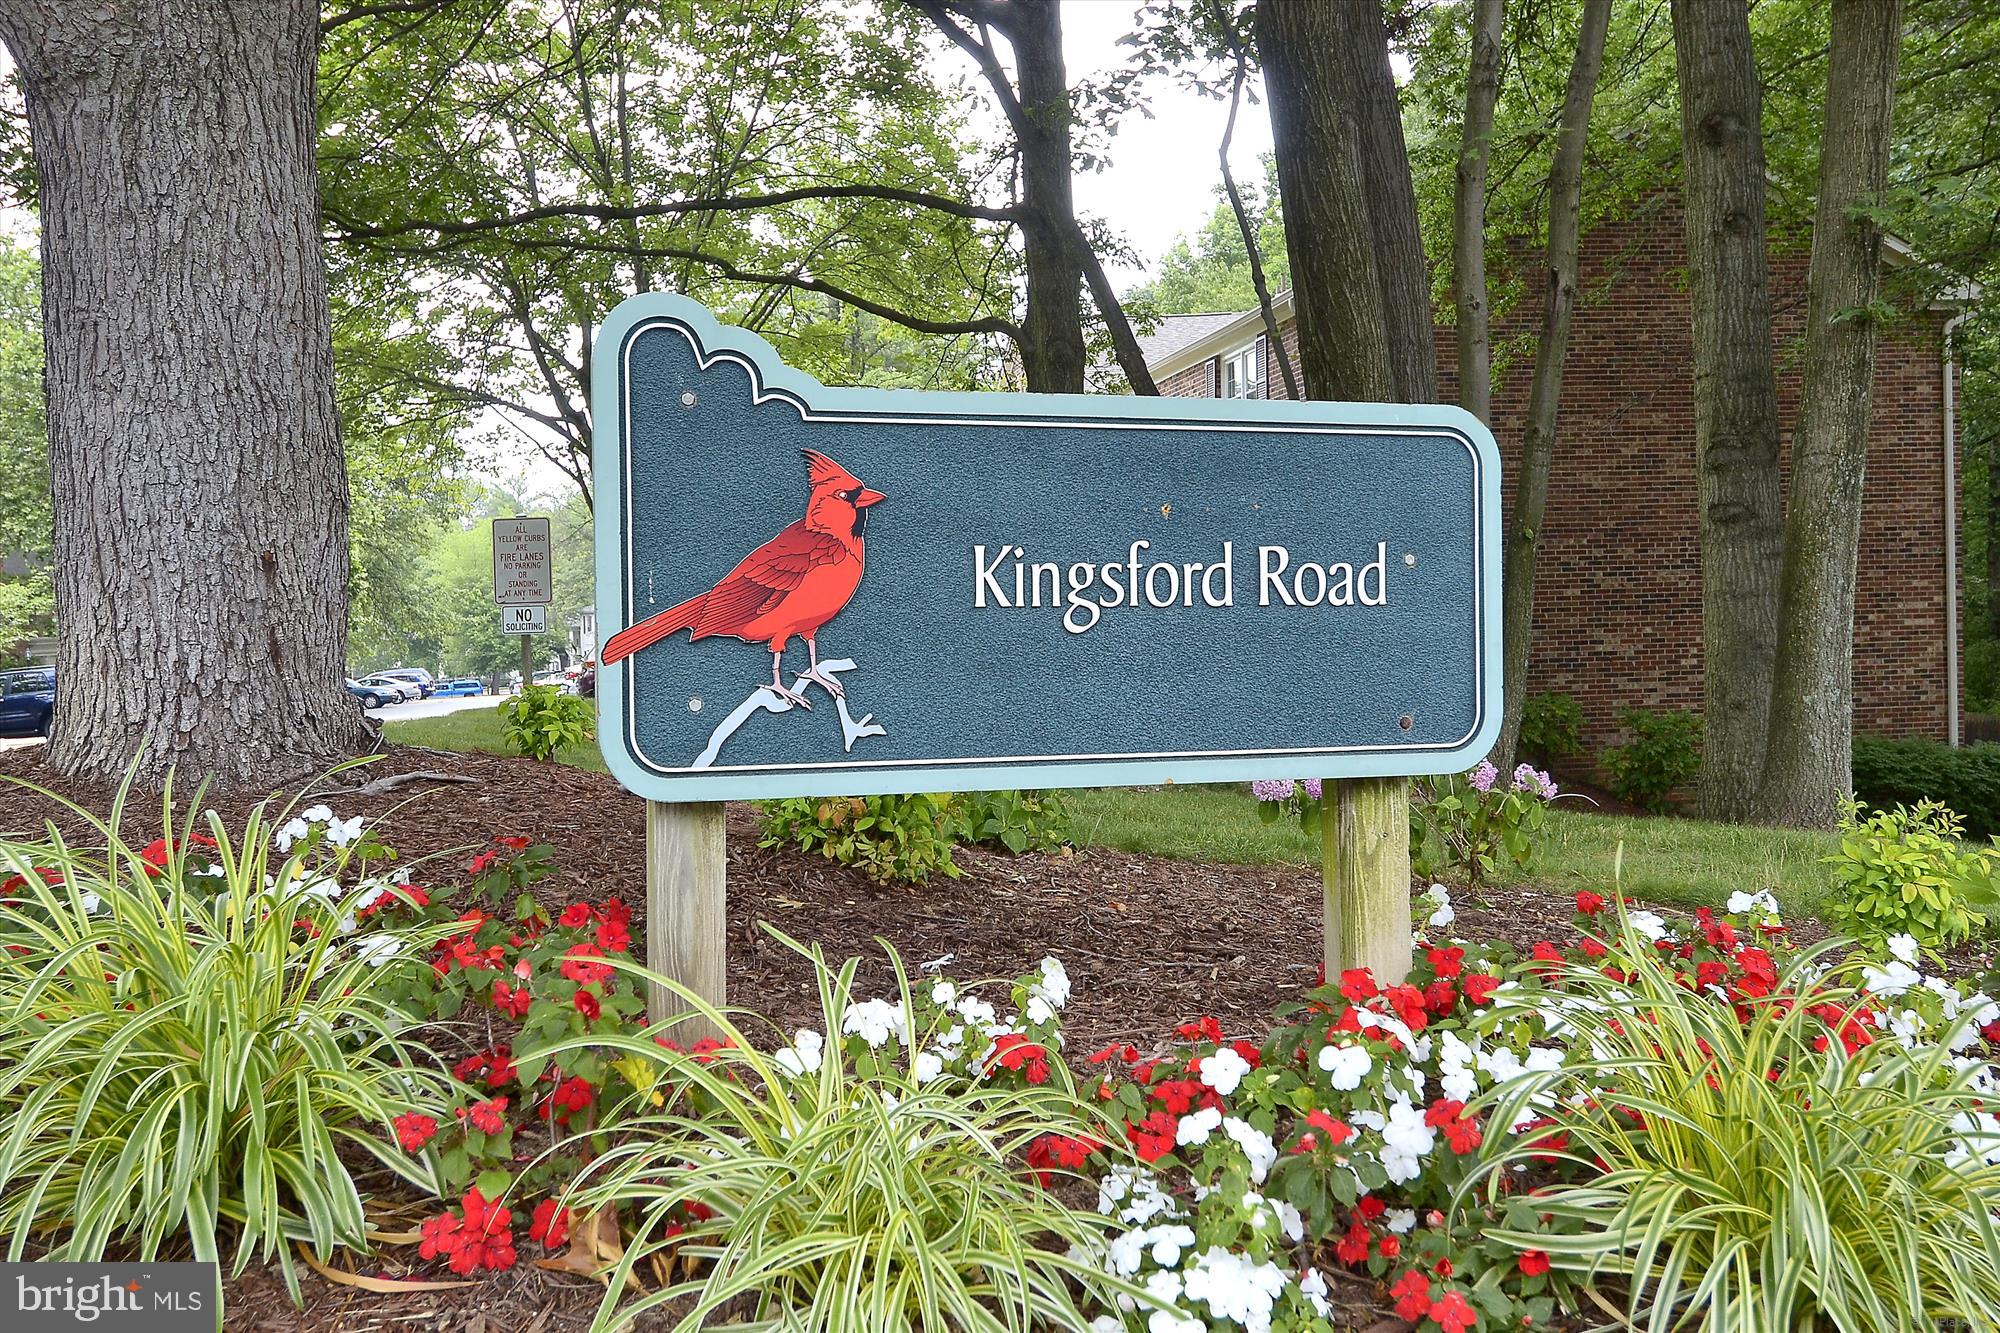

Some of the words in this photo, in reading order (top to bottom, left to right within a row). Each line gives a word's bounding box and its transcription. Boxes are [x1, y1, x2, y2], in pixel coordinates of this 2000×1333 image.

[524, 534, 546, 542] CURBS
[500, 553, 516, 562] FIRE
[519, 552, 544, 561] LANES
[504, 562, 512, 570] NO
[508, 580, 538, 588] STANDING
[973, 540, 1233, 635] Kingsford
[1258, 541, 1388, 607] Road
[516, 608, 532, 622] NO
[505, 622, 543, 631] SOLICITING
